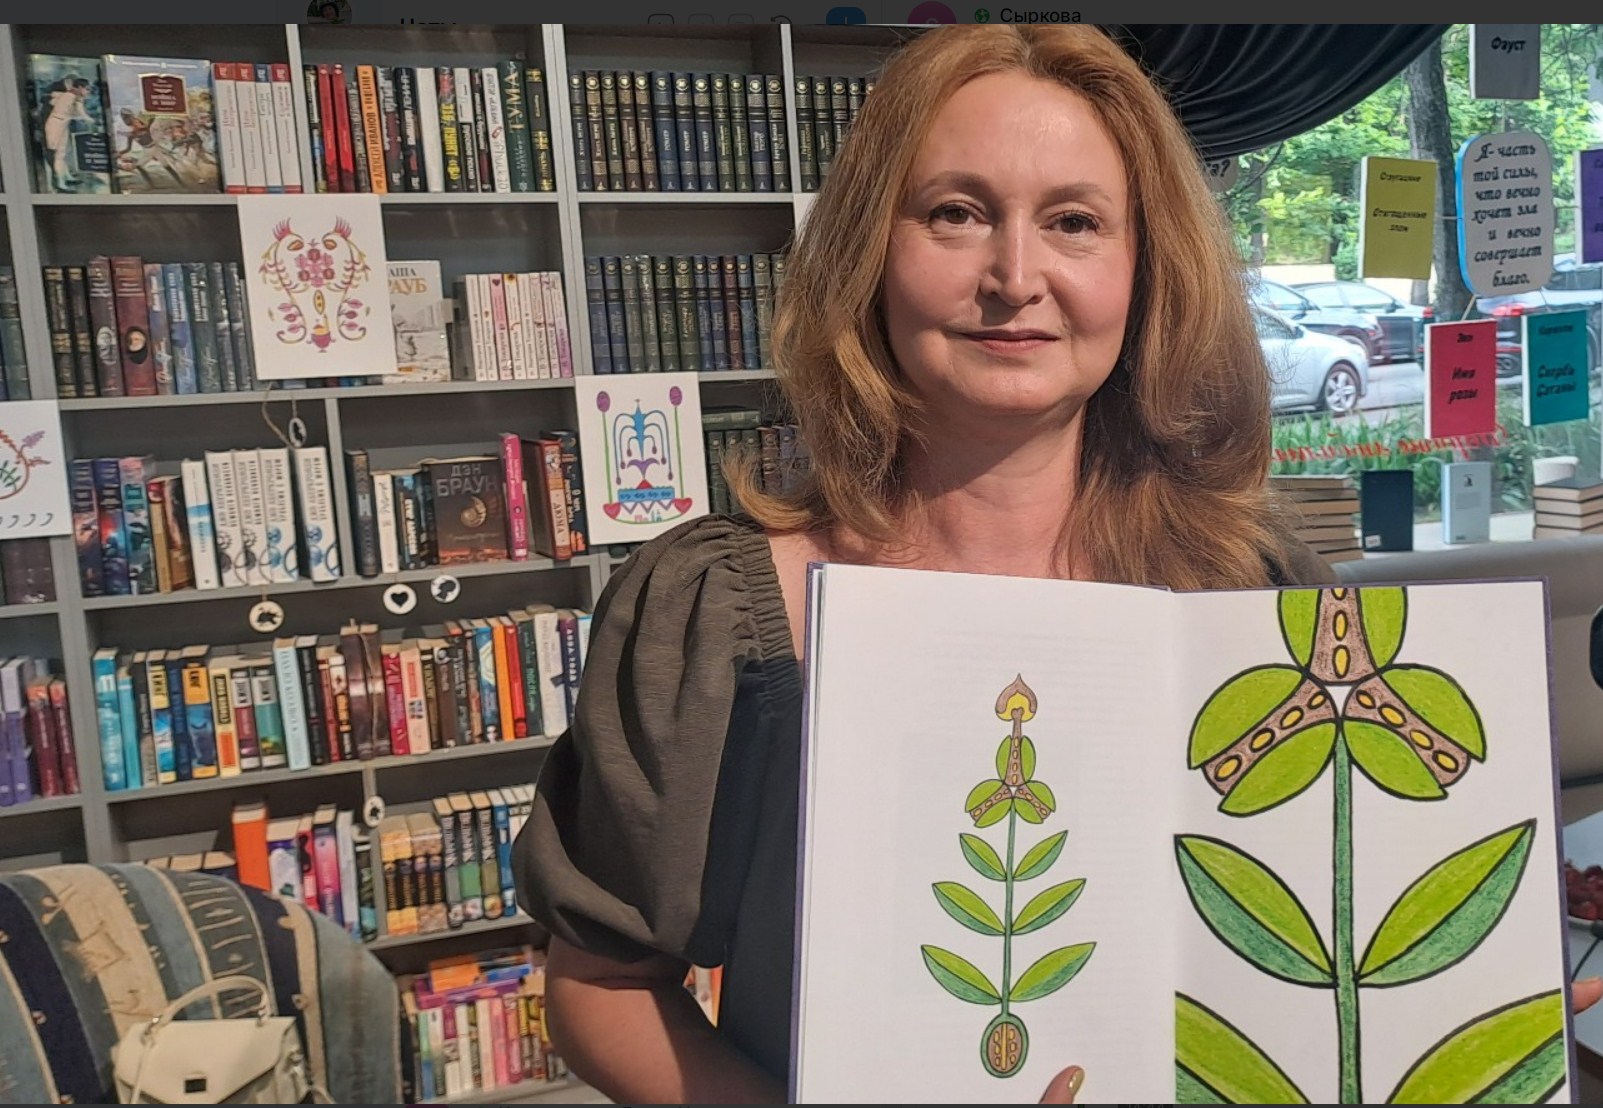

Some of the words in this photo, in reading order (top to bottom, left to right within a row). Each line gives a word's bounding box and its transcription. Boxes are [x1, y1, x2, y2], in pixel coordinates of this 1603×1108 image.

[505, 72, 525, 131] ТУМА
[443, 127, 458, 156] ПУНКТ
[1497, 144, 1536, 158] часть
[1473, 167, 1500, 182] той
[1475, 188, 1502, 201] что
[1505, 186, 1541, 200] вечно
[1471, 207, 1512, 224] хочет
[1507, 226, 1542, 239] вечно
[1473, 245, 1542, 266] совершает
[390, 268, 416, 277] АША
[1452, 367, 1476, 380] Имя
[1448, 389, 1478, 405] розы
[451, 464, 481, 477] ДЭН
[437, 476, 498, 496] БРАУН
[553, 502, 564, 534] ДЮМА
